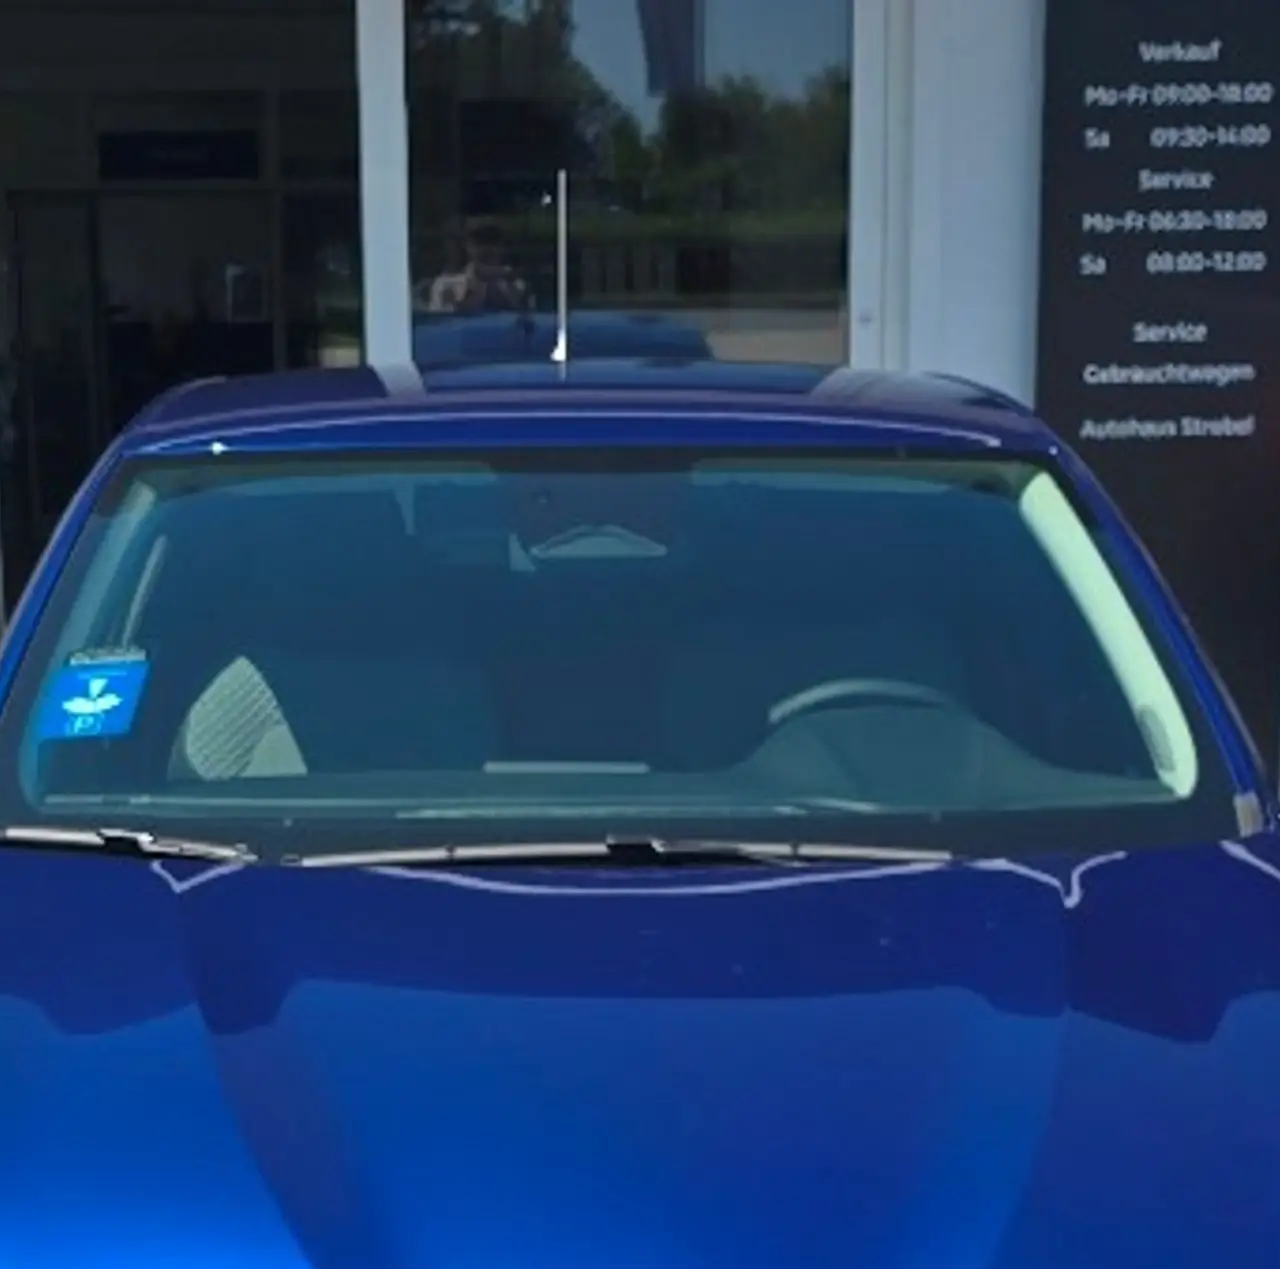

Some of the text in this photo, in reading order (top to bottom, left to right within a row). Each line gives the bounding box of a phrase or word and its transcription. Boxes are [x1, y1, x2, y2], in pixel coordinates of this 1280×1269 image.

[1138, 37, 1222, 62] Verkauf
[1084, 84, 1148, 107] Mo-Fr
[1084, 126, 1111, 149] Sa
[1138, 167, 1215, 193] Service
[1081, 211, 1144, 234] Mo-Fr
[1079, 252, 1107, 276] Sa
[1132, 321, 1208, 343] Service
[1082, 362, 1256, 388] Gebrauchtwagen
[1079, 413, 1257, 441] Autohaus Strobel
